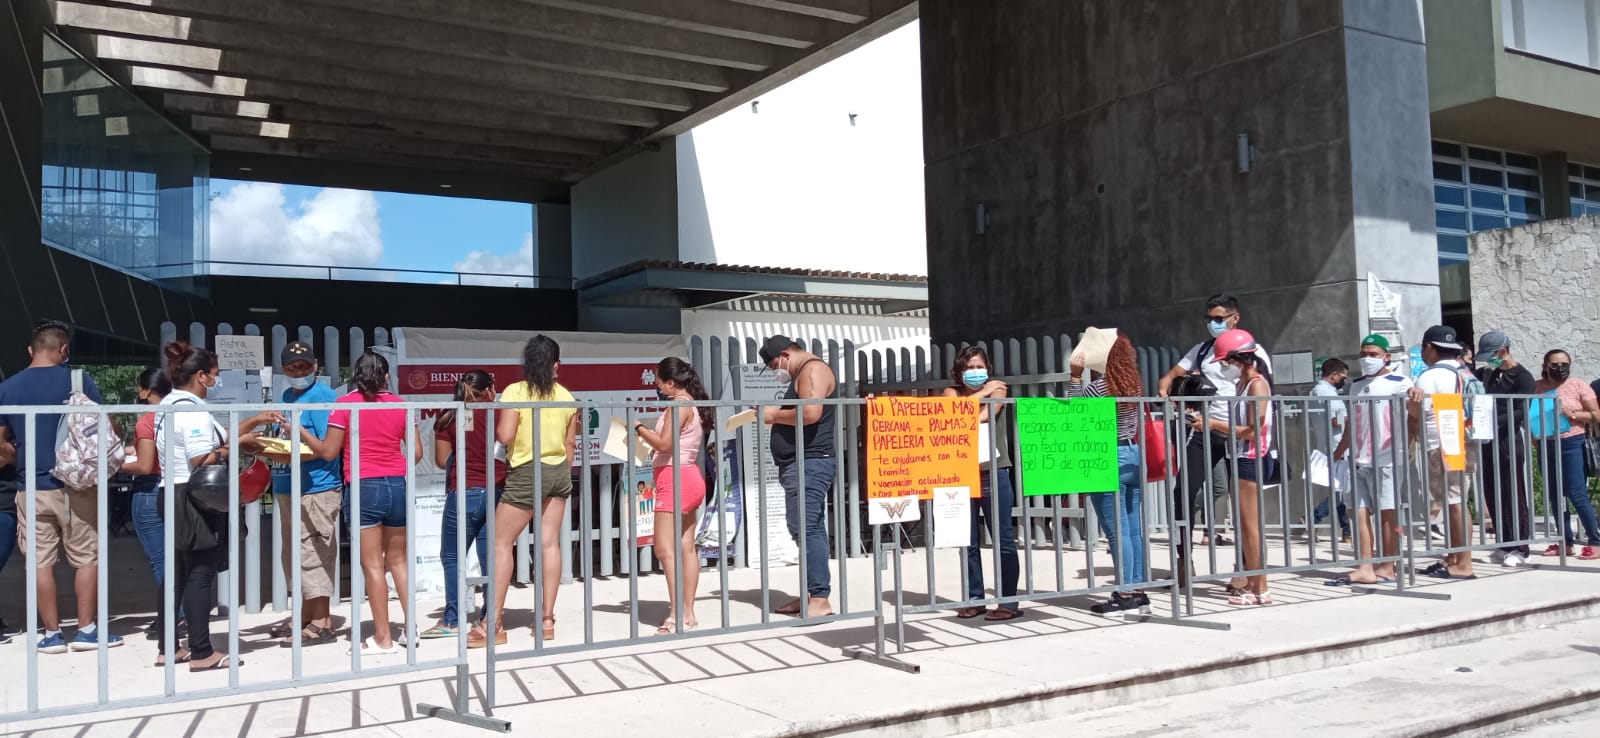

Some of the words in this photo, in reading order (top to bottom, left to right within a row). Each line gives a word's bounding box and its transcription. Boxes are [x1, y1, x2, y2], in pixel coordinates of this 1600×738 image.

[872, 419, 911, 432] CERCANA
[929, 417, 967, 432] PALMAS
[970, 416, 977, 431] 2
[1061, 416, 1074, 432] de
[872, 435, 925, 450] PAPELERIA
[929, 434, 971, 447] WONDER
[1043, 454, 1055, 469] 15
[1060, 454, 1073, 469] de
[1079, 456, 1109, 478] agosto
